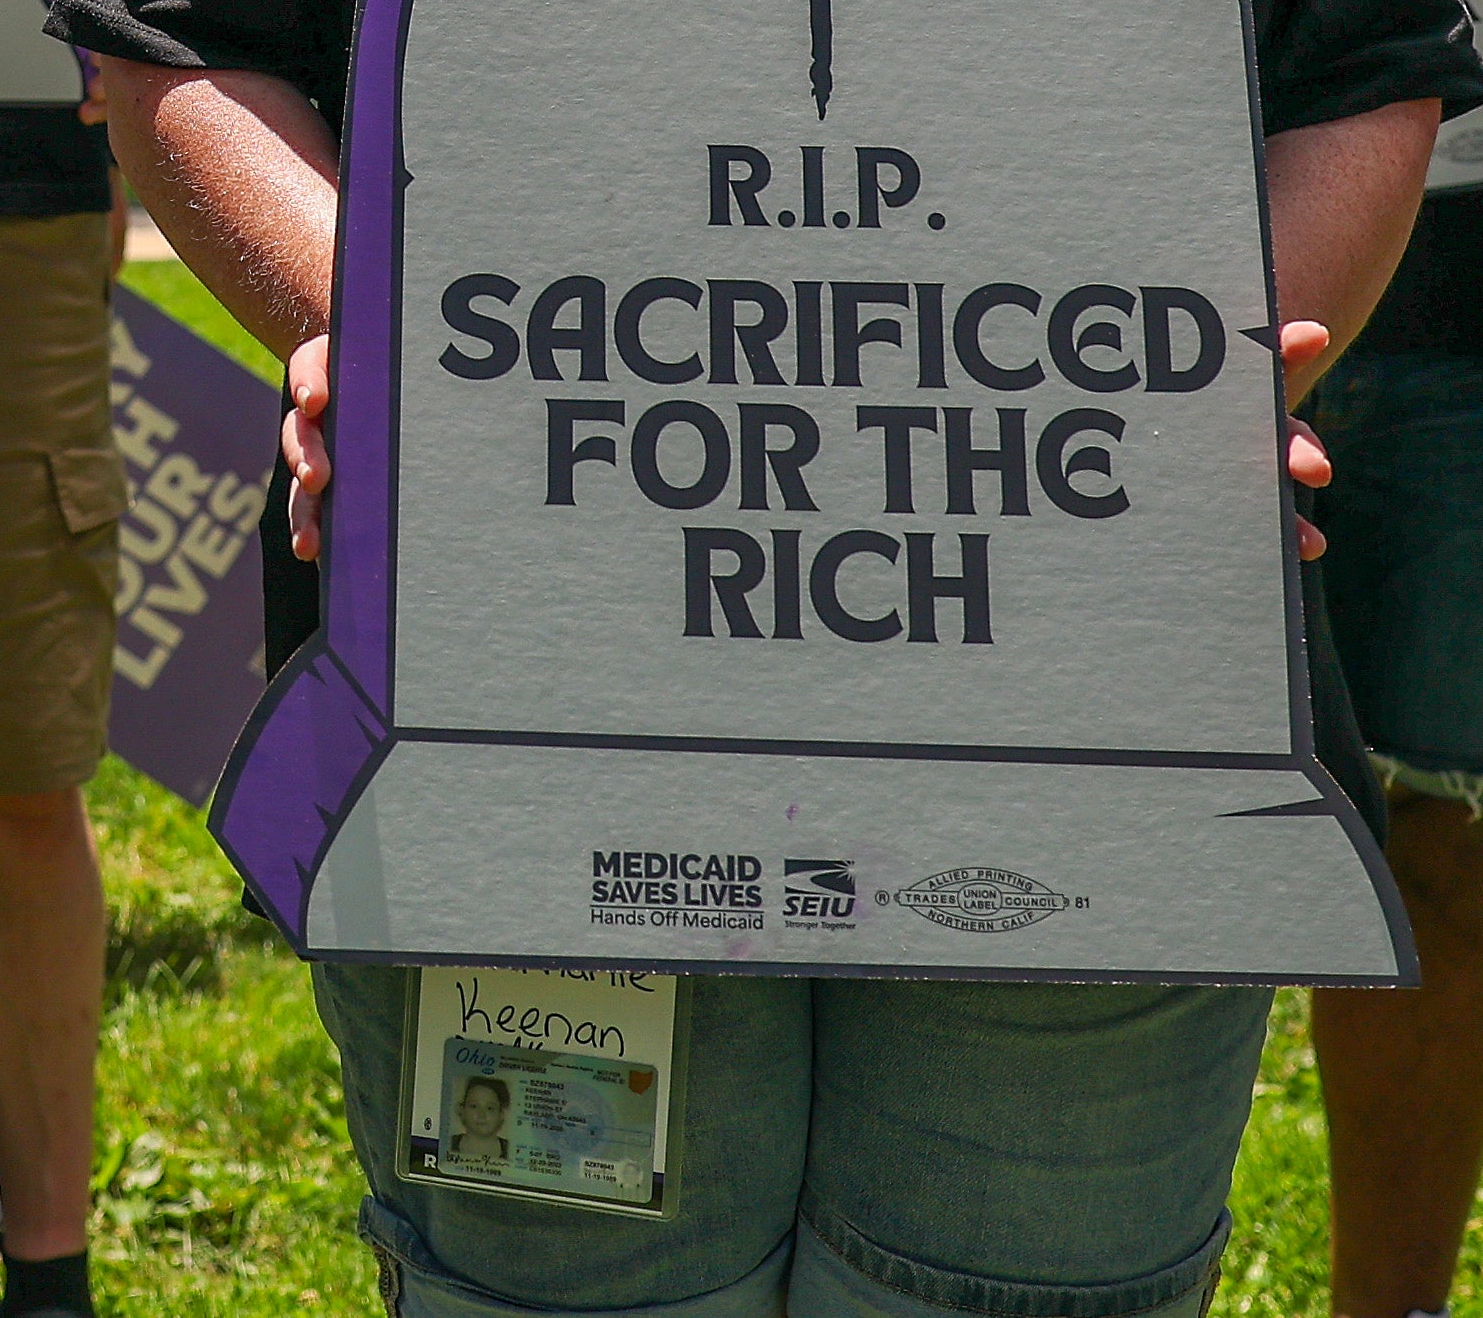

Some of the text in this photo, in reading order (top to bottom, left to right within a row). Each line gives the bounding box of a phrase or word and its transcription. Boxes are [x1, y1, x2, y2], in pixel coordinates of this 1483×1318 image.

[706, 144, 946, 230] R.I.P.
[438, 272, 1227, 393] SACRIFICED
[543, 398, 1131, 519] FOR THE
[682, 526, 995, 646] RICH
[592, 850, 763, 883] MEDICAID
[928, 870, 1033, 892] ALLIED PRINTING
[591, 880, 763, 908] SAVES LIVES
[905, 893, 1059, 908] TRADES COUNCIL
[963, 890, 997, 899] UNION
[963, 899, 998, 911] LABEL
[1074, 897, 1091, 909] 81
[782, 895, 857, 918] SEIU
[590, 909, 764, 930] Hands Off Medicaid
[784, 920, 857, 931] Stronger Together
[928, 909, 1035, 931] NORTHERN CALIF
[456, 976, 625, 1058] Keenan
